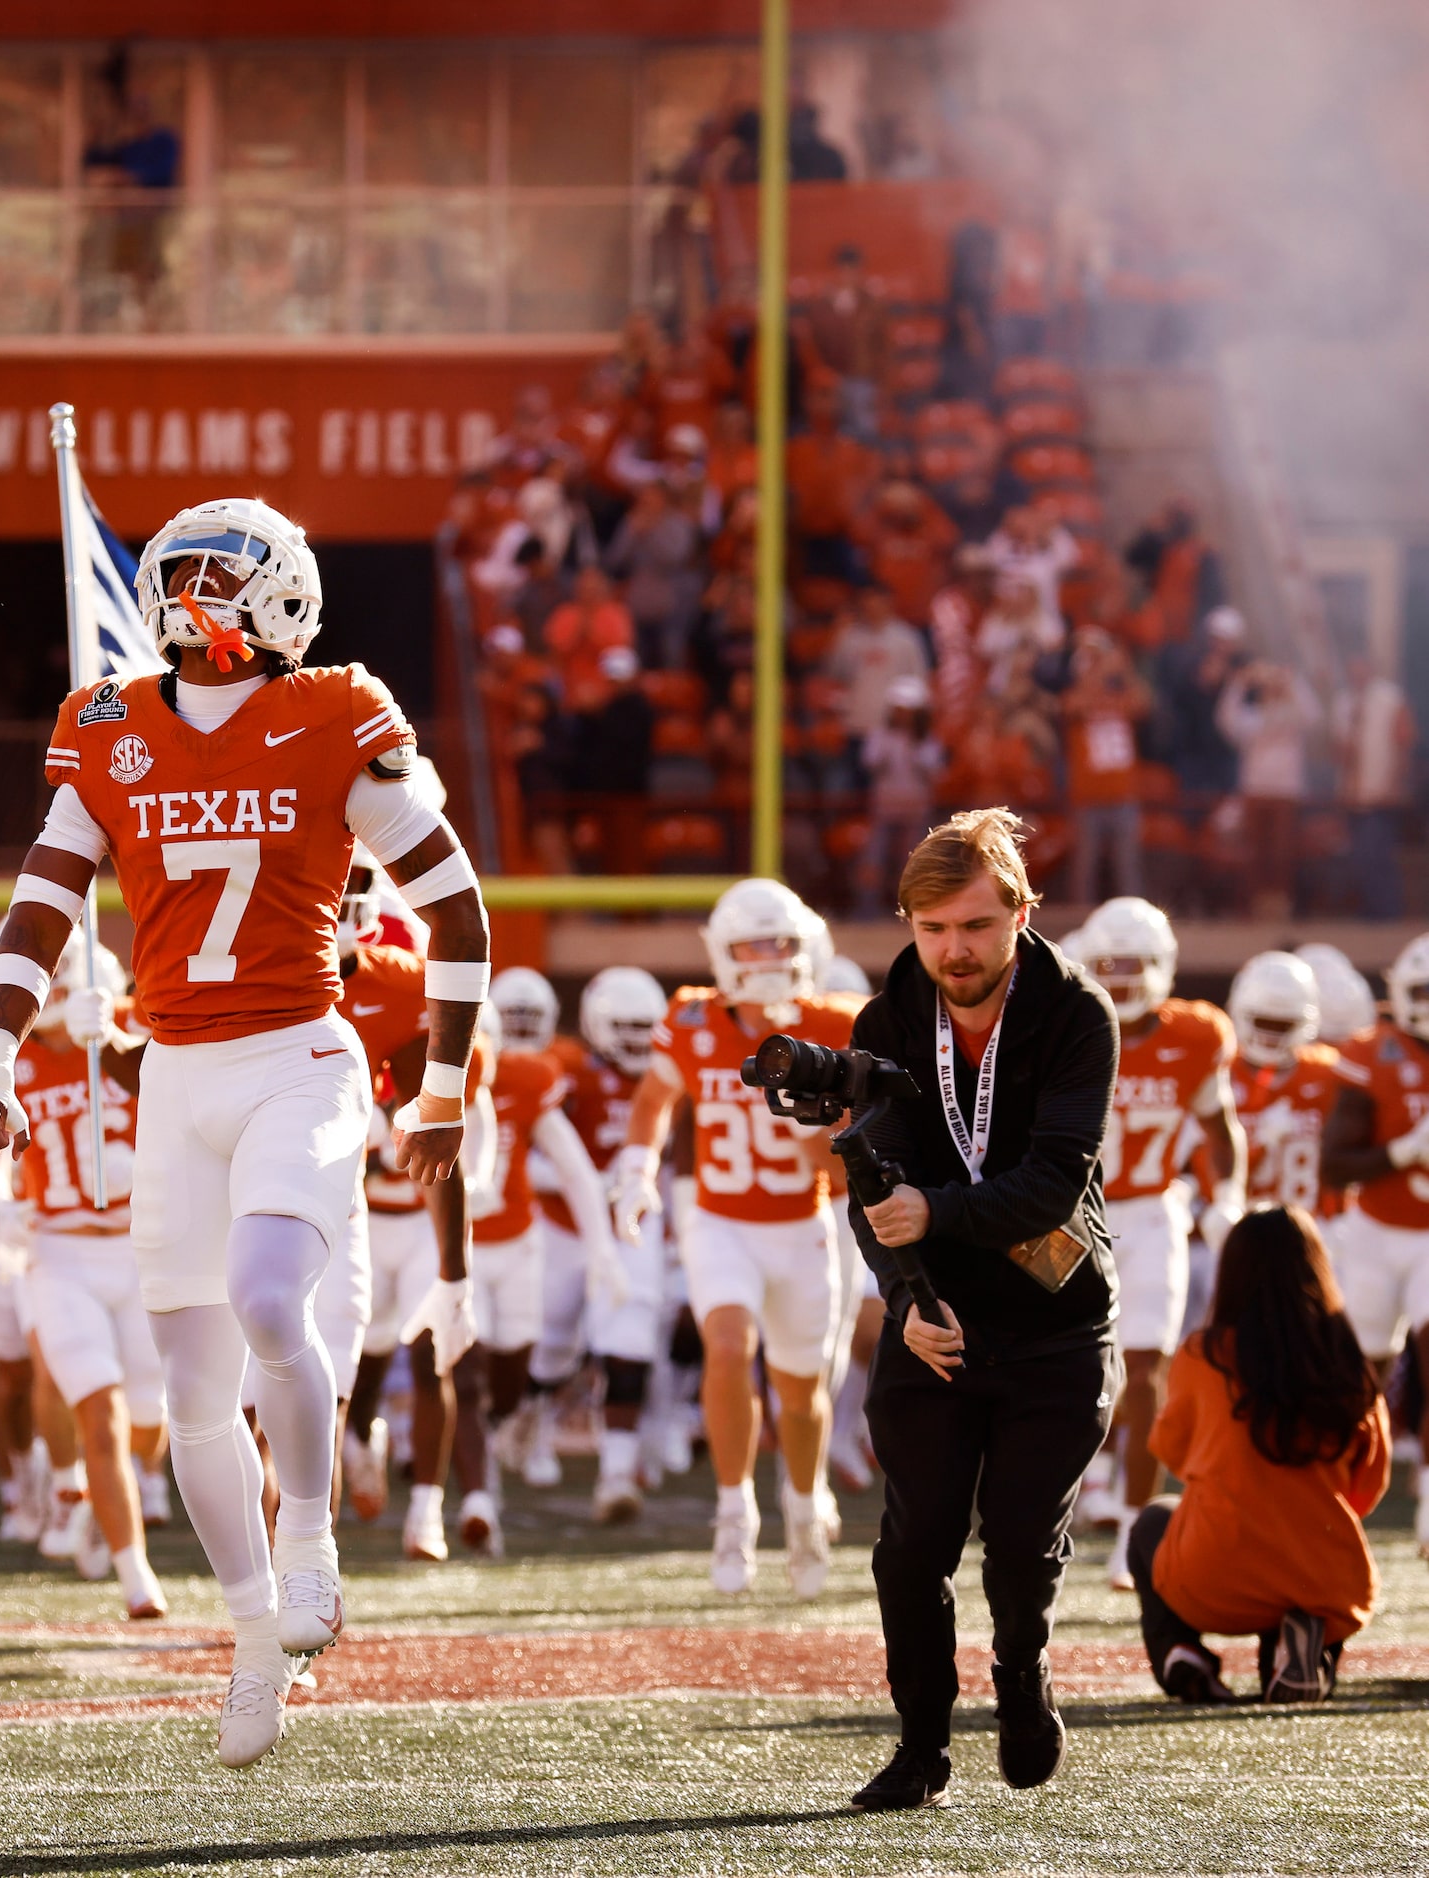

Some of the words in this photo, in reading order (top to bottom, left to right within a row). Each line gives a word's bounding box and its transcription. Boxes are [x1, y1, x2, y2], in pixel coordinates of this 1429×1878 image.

[318, 406, 496, 478] FIELD
[80, 709, 101, 719] FIRST
[100, 706, 125, 714] ROUND
[113, 765, 148, 784] GRADUATE
[114, 737, 145, 772] SEC
[128, 789, 298, 839] TEXAS
[161, 838, 261, 983] 7
[940, 1065, 951, 1082] ALL
[946, 1107, 960, 1122] NO
[980, 1076, 991, 1091] NO
[696, 1102, 818, 1195] 35
[976, 1116, 988, 1133] ALL
[35, 1107, 135, 1209] 16
